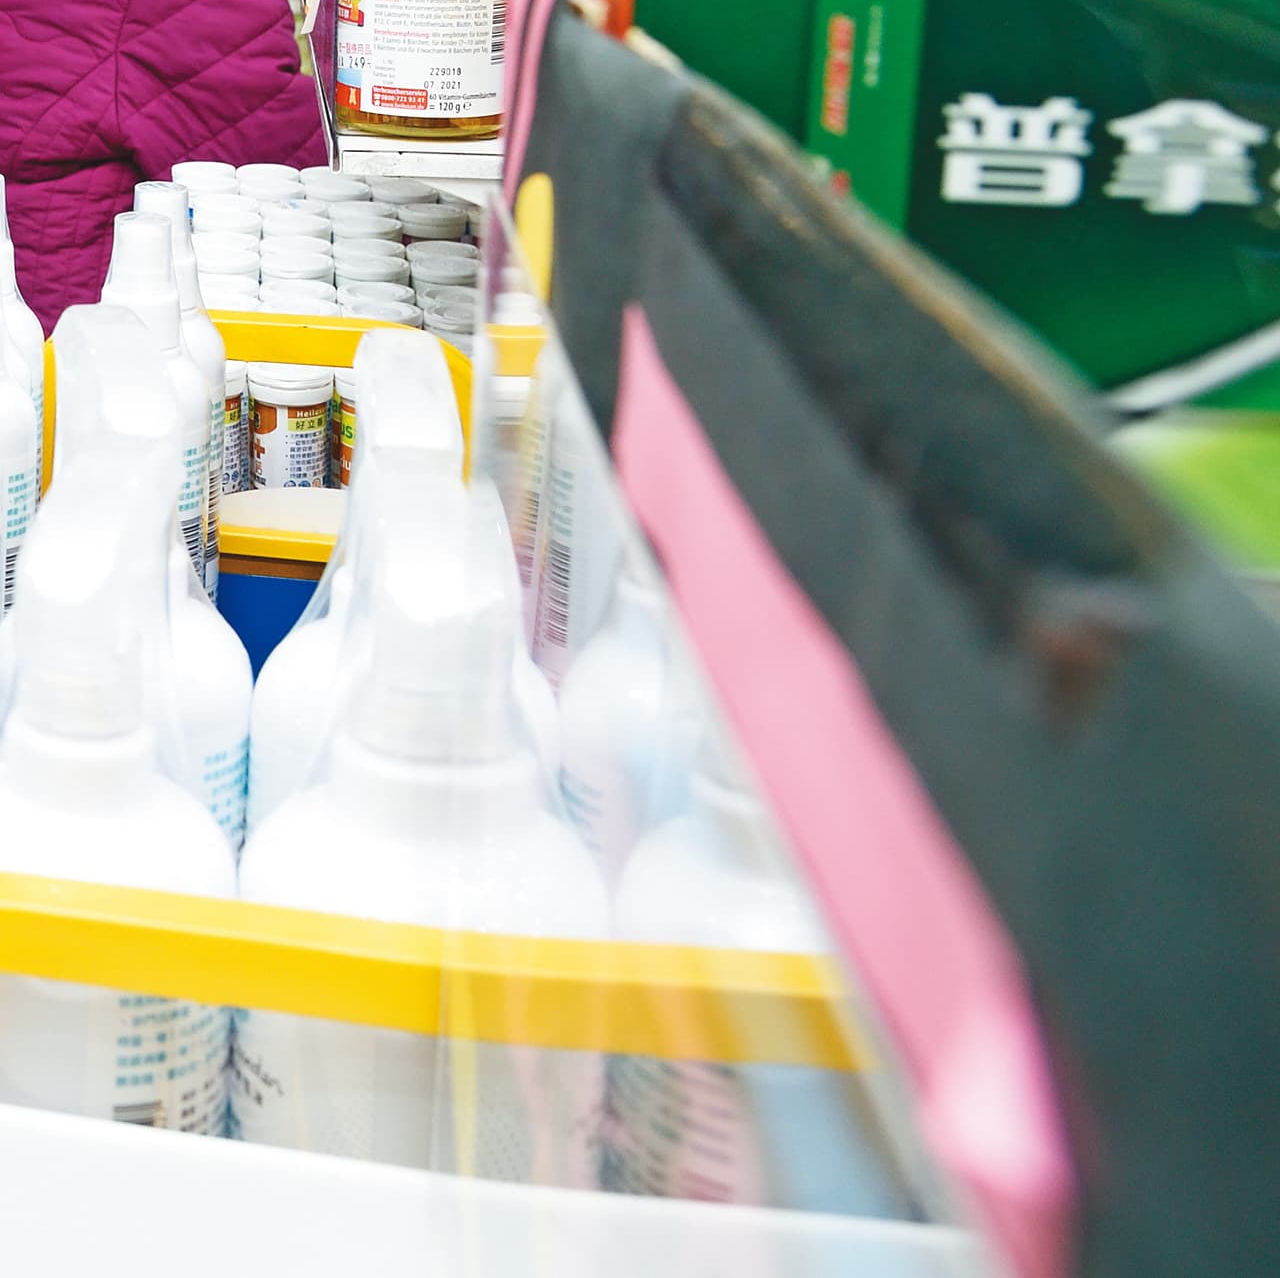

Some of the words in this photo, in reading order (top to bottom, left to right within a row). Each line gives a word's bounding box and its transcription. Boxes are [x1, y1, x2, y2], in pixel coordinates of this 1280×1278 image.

[430, 67, 462, 76] 229018
[424, 80, 434, 89] 07
[441, 80, 461, 89] 2021
[439, 102, 453, 111] 120
[938, 91, 1280, 215] 普拿
